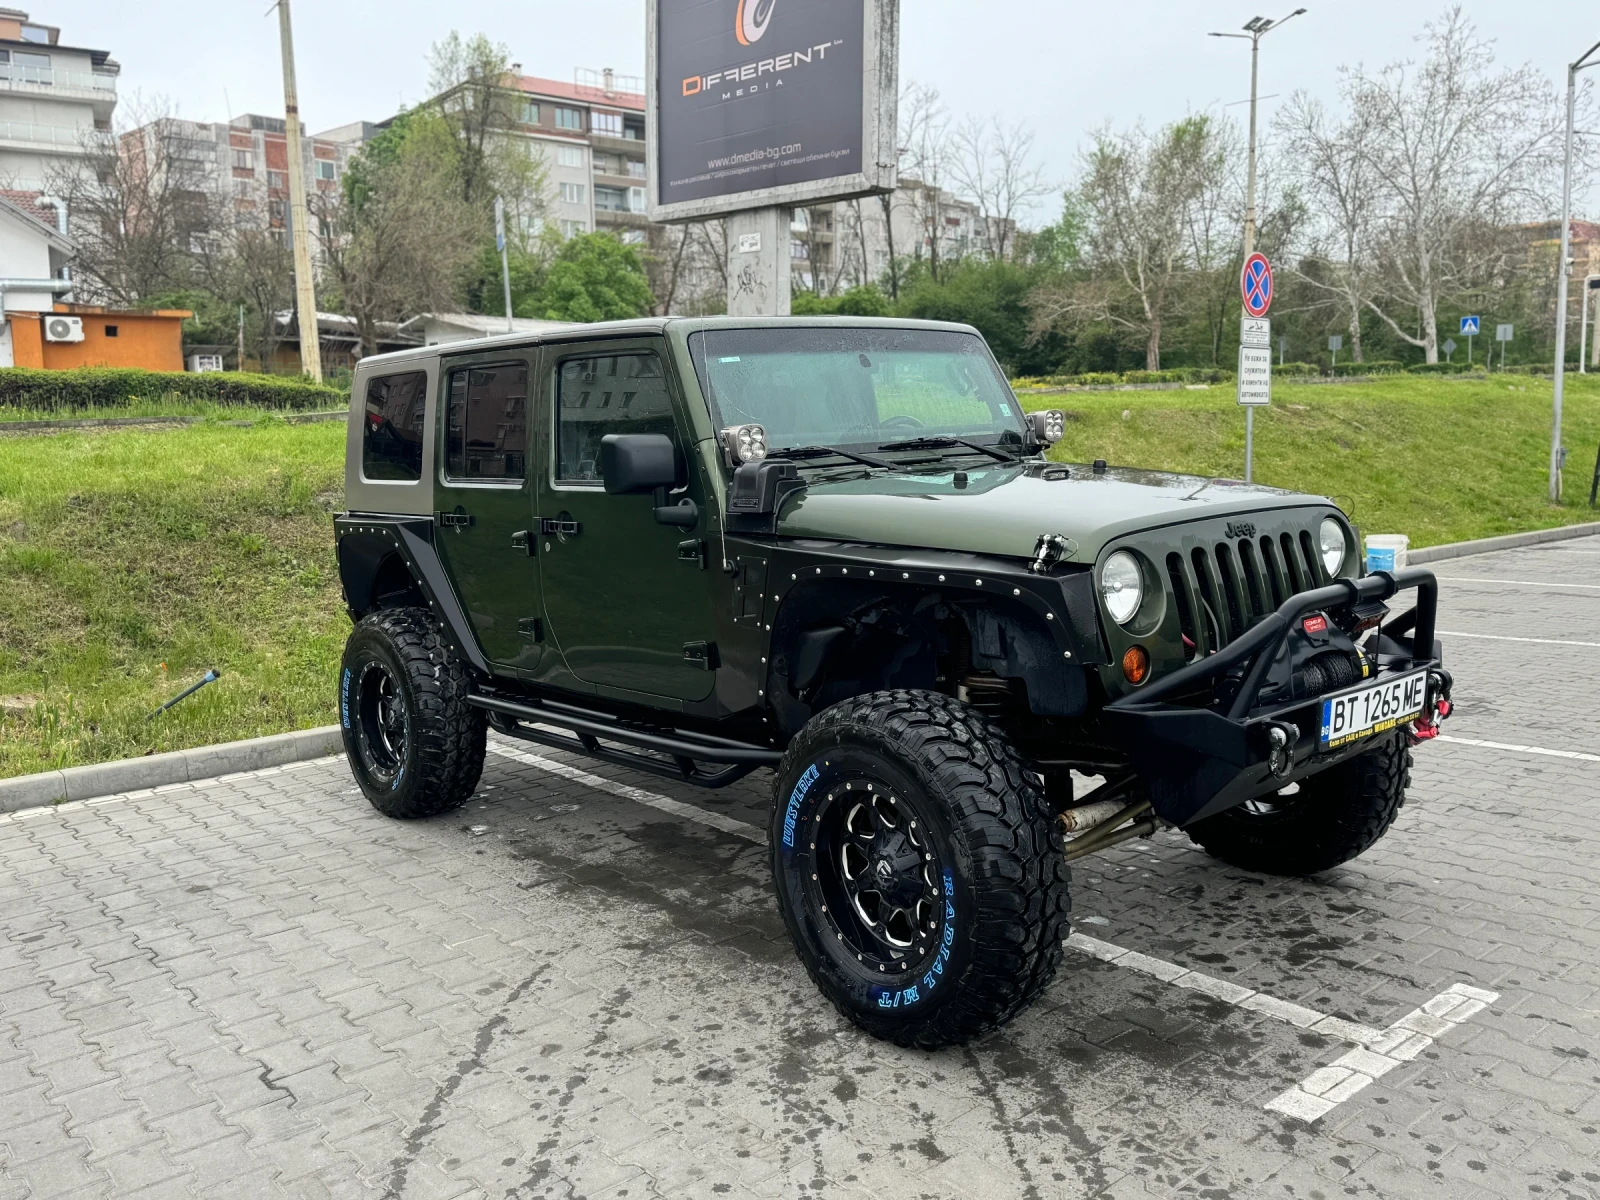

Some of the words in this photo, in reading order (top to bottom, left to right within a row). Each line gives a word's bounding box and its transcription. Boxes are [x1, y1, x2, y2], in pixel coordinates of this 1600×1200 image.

[682, 42, 832, 97] DIFFERENT
[722, 79, 783, 100] MEDIA
[707, 142, 802, 169] www.dmedia-bg.com
[1224, 521, 1256, 539] Jeep
[1333, 695, 1359, 734] BT
[1364, 683, 1401, 724] 1265
[1402, 676, 1424, 713] ME
[1321, 725, 1330, 737] BG
[782, 763, 820, 847] WESTLAKE
[924, 875, 955, 989] RADIAL
[878, 985, 920, 1008] M/T
